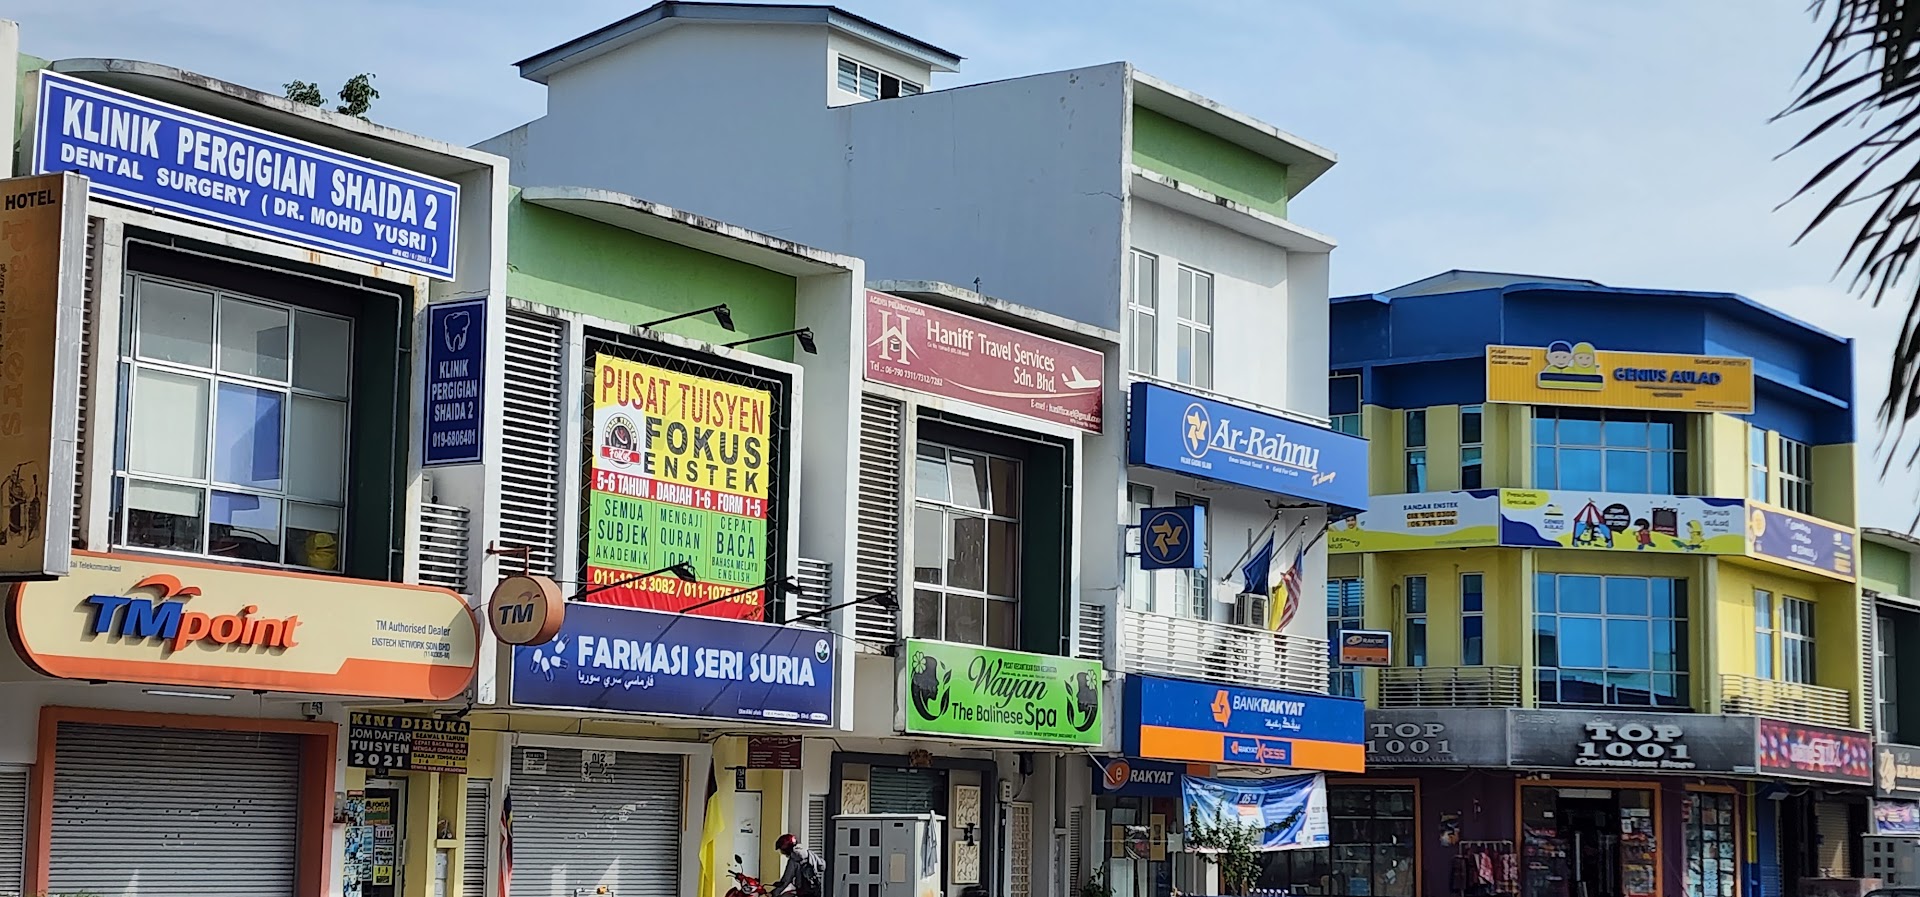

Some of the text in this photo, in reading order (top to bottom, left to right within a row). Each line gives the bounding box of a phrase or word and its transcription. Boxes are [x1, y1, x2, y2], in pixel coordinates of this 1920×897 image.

[63, 96, 438, 230] KLINIK PERGIGIAN SHAIDA 2
[5, 189, 55, 210] HOTEL
[60, 142, 143, 181] DENTAL
[157, 168, 250, 207] SURGERY
[273, 196, 304, 221] DR.
[310, 206, 362, 235] MOHD
[372, 223, 426, 251] YUSRI
[927, 319, 974, 350] Haniff
[978, 333, 1011, 360] Travel
[1014, 343, 1055, 373] Services
[439, 359, 469, 379] KLINIK
[1613, 368, 1722, 385] GENIUS AULAD
[432, 380, 477, 401] PERGIGIAN
[1013, 367, 1057, 394] Sdn. Bhd.
[602, 365, 764, 435] PUSAT TUISYEN
[434, 401, 473, 422] SHAIDA 2
[645, 416, 762, 470] FOKUS
[1211, 419, 1319, 470] Ar-Rahnu
[644, 451, 759, 494] ENSTEK
[597, 471, 761, 517] 5-6 TAHUN DARJAH 1-6 FORM 1-5
[605, 499, 644, 522] SEMUA
[1403, 502, 1458, 511] BANDAR ENSTEK
[660, 508, 703, 528] MENGAJI
[721, 516, 752, 534] CEPAT
[598, 519, 648, 546] SUBJEK
[660, 528, 700, 549] QURAN
[596, 545, 648, 565] AKADEMIK
[716, 532, 755, 559] BACA
[712, 557, 758, 572] BAHASA MELAYU
[649, 577, 675, 595] 3082
[718, 568, 750, 583] ENGLISH
[498, 603, 534, 625] TM
[376, 620, 451, 636] TM Authorised Dealer
[371, 637, 396, 647] ENSTECH
[577, 635, 815, 687] FARMASI SERI SURIA
[968, 655, 1049, 709] Wayan
[351, 714, 467, 733] KINI DIBUKA
[951, 701, 1057, 730] The Balinese Spa
[350, 728, 411, 742] JOM DAFTAR
[1370, 723, 1445, 738] TOP
[1585, 722, 1683, 743] TOP
[1365, 740, 1452, 753] 1001
[1577, 742, 1691, 759] 1001
[354, 753, 403, 767] 2021
[1660, 760, 1696, 769] Store
[1130, 769, 1174, 785] RAKYAT
